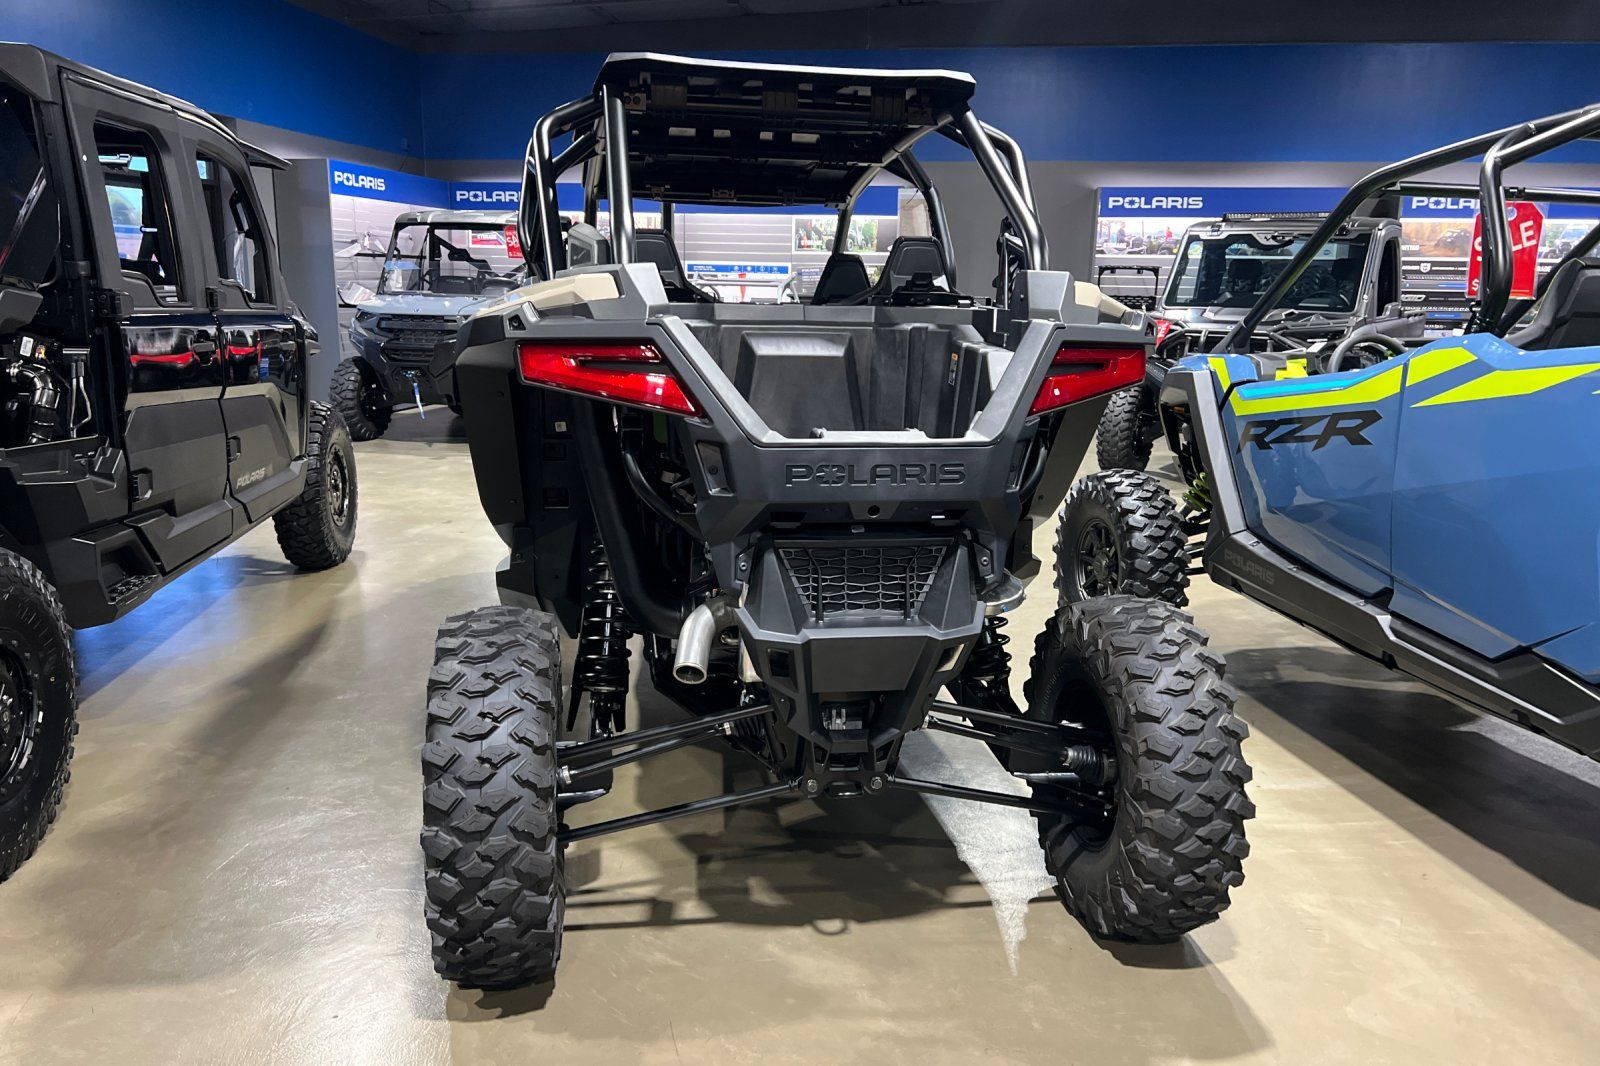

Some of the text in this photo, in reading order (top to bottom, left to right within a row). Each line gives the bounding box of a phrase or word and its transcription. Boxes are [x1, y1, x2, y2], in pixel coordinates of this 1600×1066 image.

[334, 171, 386, 191] POLARIS
[1108, 196, 1203, 209] POLARIS
[1235, 409, 1383, 454] RZR
[235, 467, 266, 490] POLARIS
[785, 463, 966, 488] POLARIS
[1223, 551, 1275, 585] POLARIS
